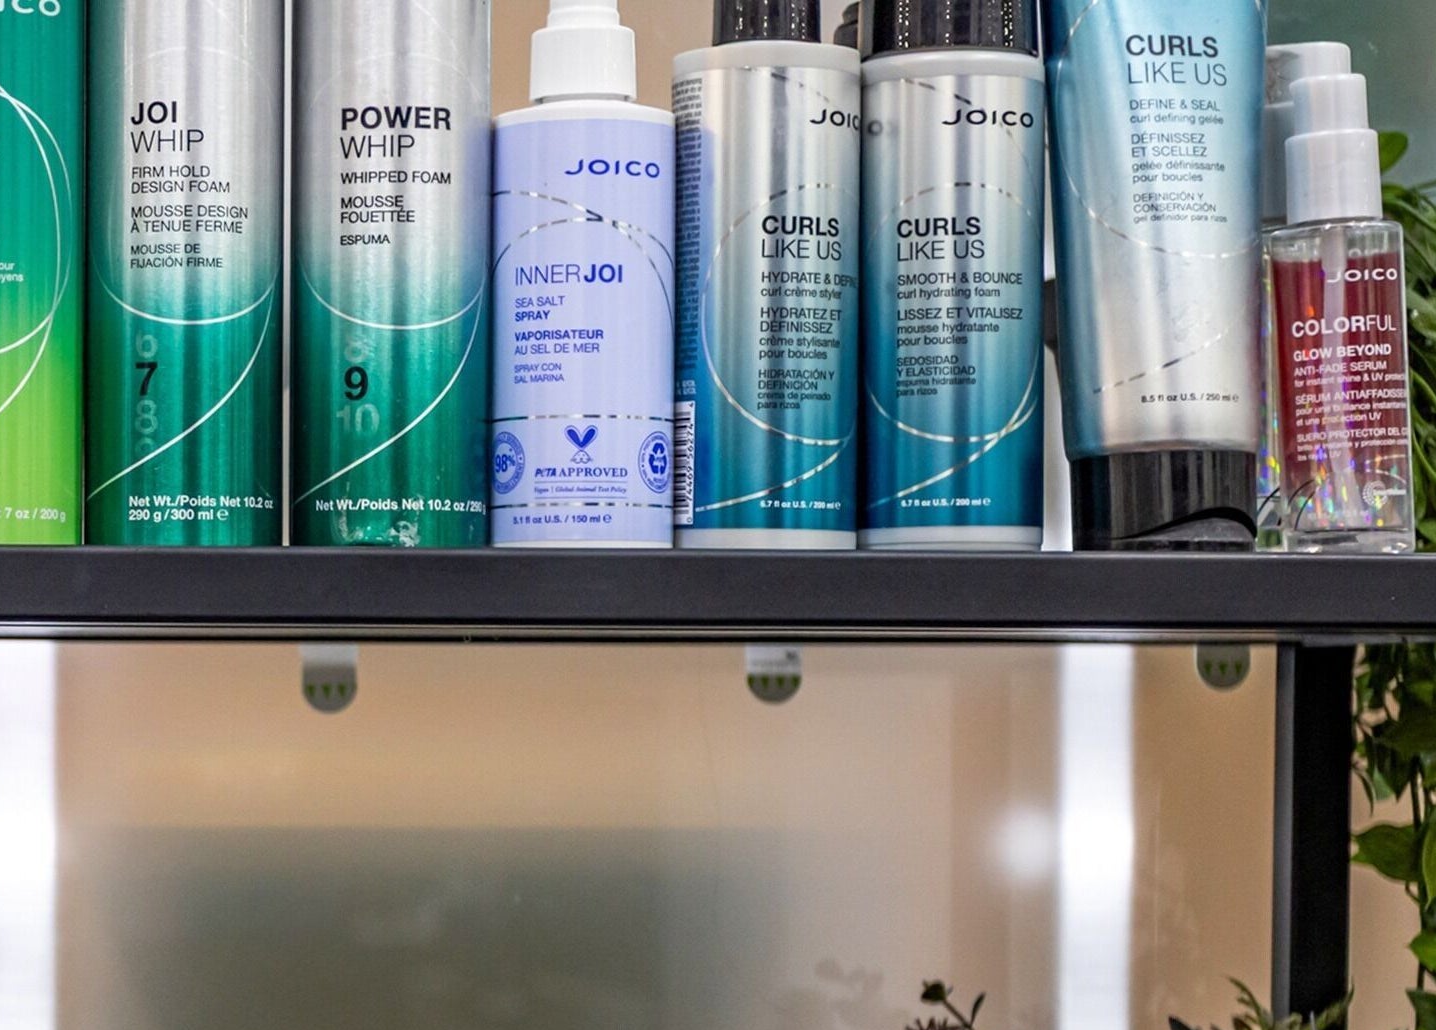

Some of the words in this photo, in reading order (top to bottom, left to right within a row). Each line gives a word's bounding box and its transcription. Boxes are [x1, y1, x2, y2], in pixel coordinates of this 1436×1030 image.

[1126, 35, 1218, 57] CURLS
[1128, 62, 1186, 84] LIKE
[1195, 63, 1227, 86] US
[1130, 99, 1175, 110] DEFINE
[1192, 100, 1220, 111] SEAL
[131, 101, 176, 125] JOI
[341, 106, 451, 130] POWER
[810, 109, 860, 131] JOIC
[942, 109, 1033, 128] JOICO
[131, 129, 204, 153] WHIP
[340, 135, 415, 159] WHIP
[1132, 147, 1147, 158] ET
[132, 166, 164, 178] FIRM
[170, 165, 210, 177] HOLD
[565, 159, 660, 178] JOICO
[341, 171, 407, 184] WHIPPED
[412, 172, 451, 184] FOAM
[132, 181, 184, 194] DESIGN
[189, 182, 230, 193] FOAM
[341, 195, 403, 208] MOUSSE
[131, 205, 193, 218] MOUSSE
[198, 206, 248, 219] DESIGN
[341, 207, 415, 223] FOUETTÉE
[144, 220, 191, 232] TENUE
[196, 220, 242, 233] FERME
[762, 215, 839, 237] CURLS
[897, 217, 981, 238] CURLS
[341, 235, 390, 245] ESPUMA
[761, 239, 809, 258] LIKE
[817, 240, 841, 261] US
[897, 241, 945, 262] LIKE
[954, 240, 985, 259] US
[515, 264, 623, 286] INNERJOI
[897, 273, 956, 286] SMOOTH
[973, 272, 1022, 285] BOUNCE
[1327, 268, 1397, 283] JOICO
[761, 288, 782, 297] curl
[919, 287, 971, 299] hydrating
[515, 297, 534, 308] SEA
[537, 296, 564, 306] SALT
[515, 310, 550, 322] SPRAY
[1292, 315, 1396, 338] COLORFUL
[515, 329, 604, 342] VAPORISATEUR
[515, 345, 527, 355] AU
[530, 344, 550, 353] SEL
[554, 344, 570, 353] DE
[574, 343, 600, 353] MER
[1293, 348, 1334, 362] GLOW
[1337, 344, 1391, 357] BEYOND
[135, 362, 158, 396] 7
[345, 366, 368, 400] 9
[559, 468, 627, 478] APPROVED
[129, 496, 149, 507] Net
[220, 496, 240, 507] Net
[129, 510, 150, 520] 290
[171, 509, 194, 520] 300
[198, 510, 213, 520] ml
